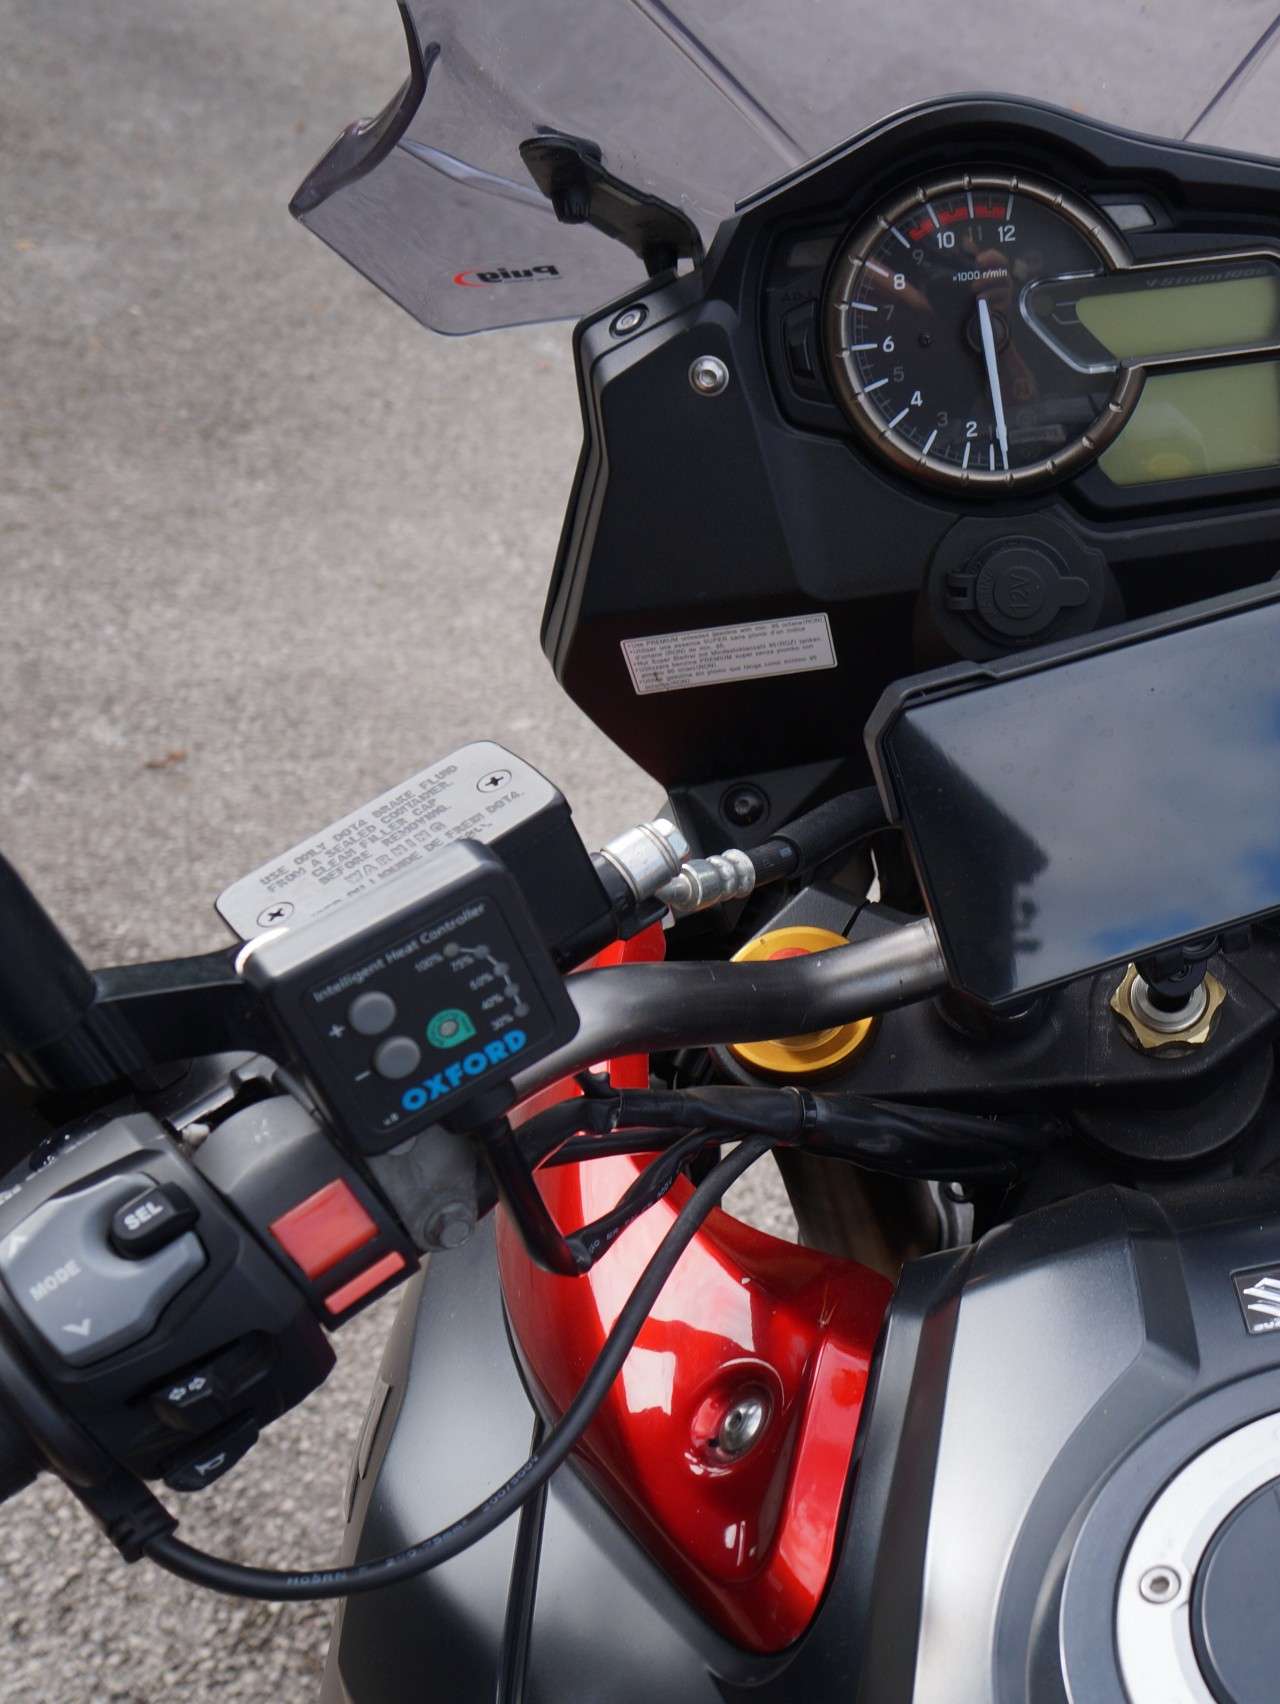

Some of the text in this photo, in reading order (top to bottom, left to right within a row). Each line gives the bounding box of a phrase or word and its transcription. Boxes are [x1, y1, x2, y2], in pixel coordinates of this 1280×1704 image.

[936, 231, 956, 249] 10
[998, 225, 1016, 243] 12
[912, 249, 924, 265] 9
[893, 273, 906, 290] 8
[883, 304, 895, 321] 7
[882, 336, 895, 352] 6
[893, 366, 905, 382] 5
[910, 390, 924, 407] 4
[936, 411, 949, 428] 3
[966, 421, 978, 437] 2
[333, 818, 368, 842] DOT4
[372, 790, 417, 819] BRAKE
[412, 798, 438, 817] CAP
[313, 902, 487, 1003] Intelligent Heat Controller
[400, 1029, 528, 1112] OXFORD
[123, 1201, 163, 1231] SEL
[30, 1260, 82, 1301] MODE
